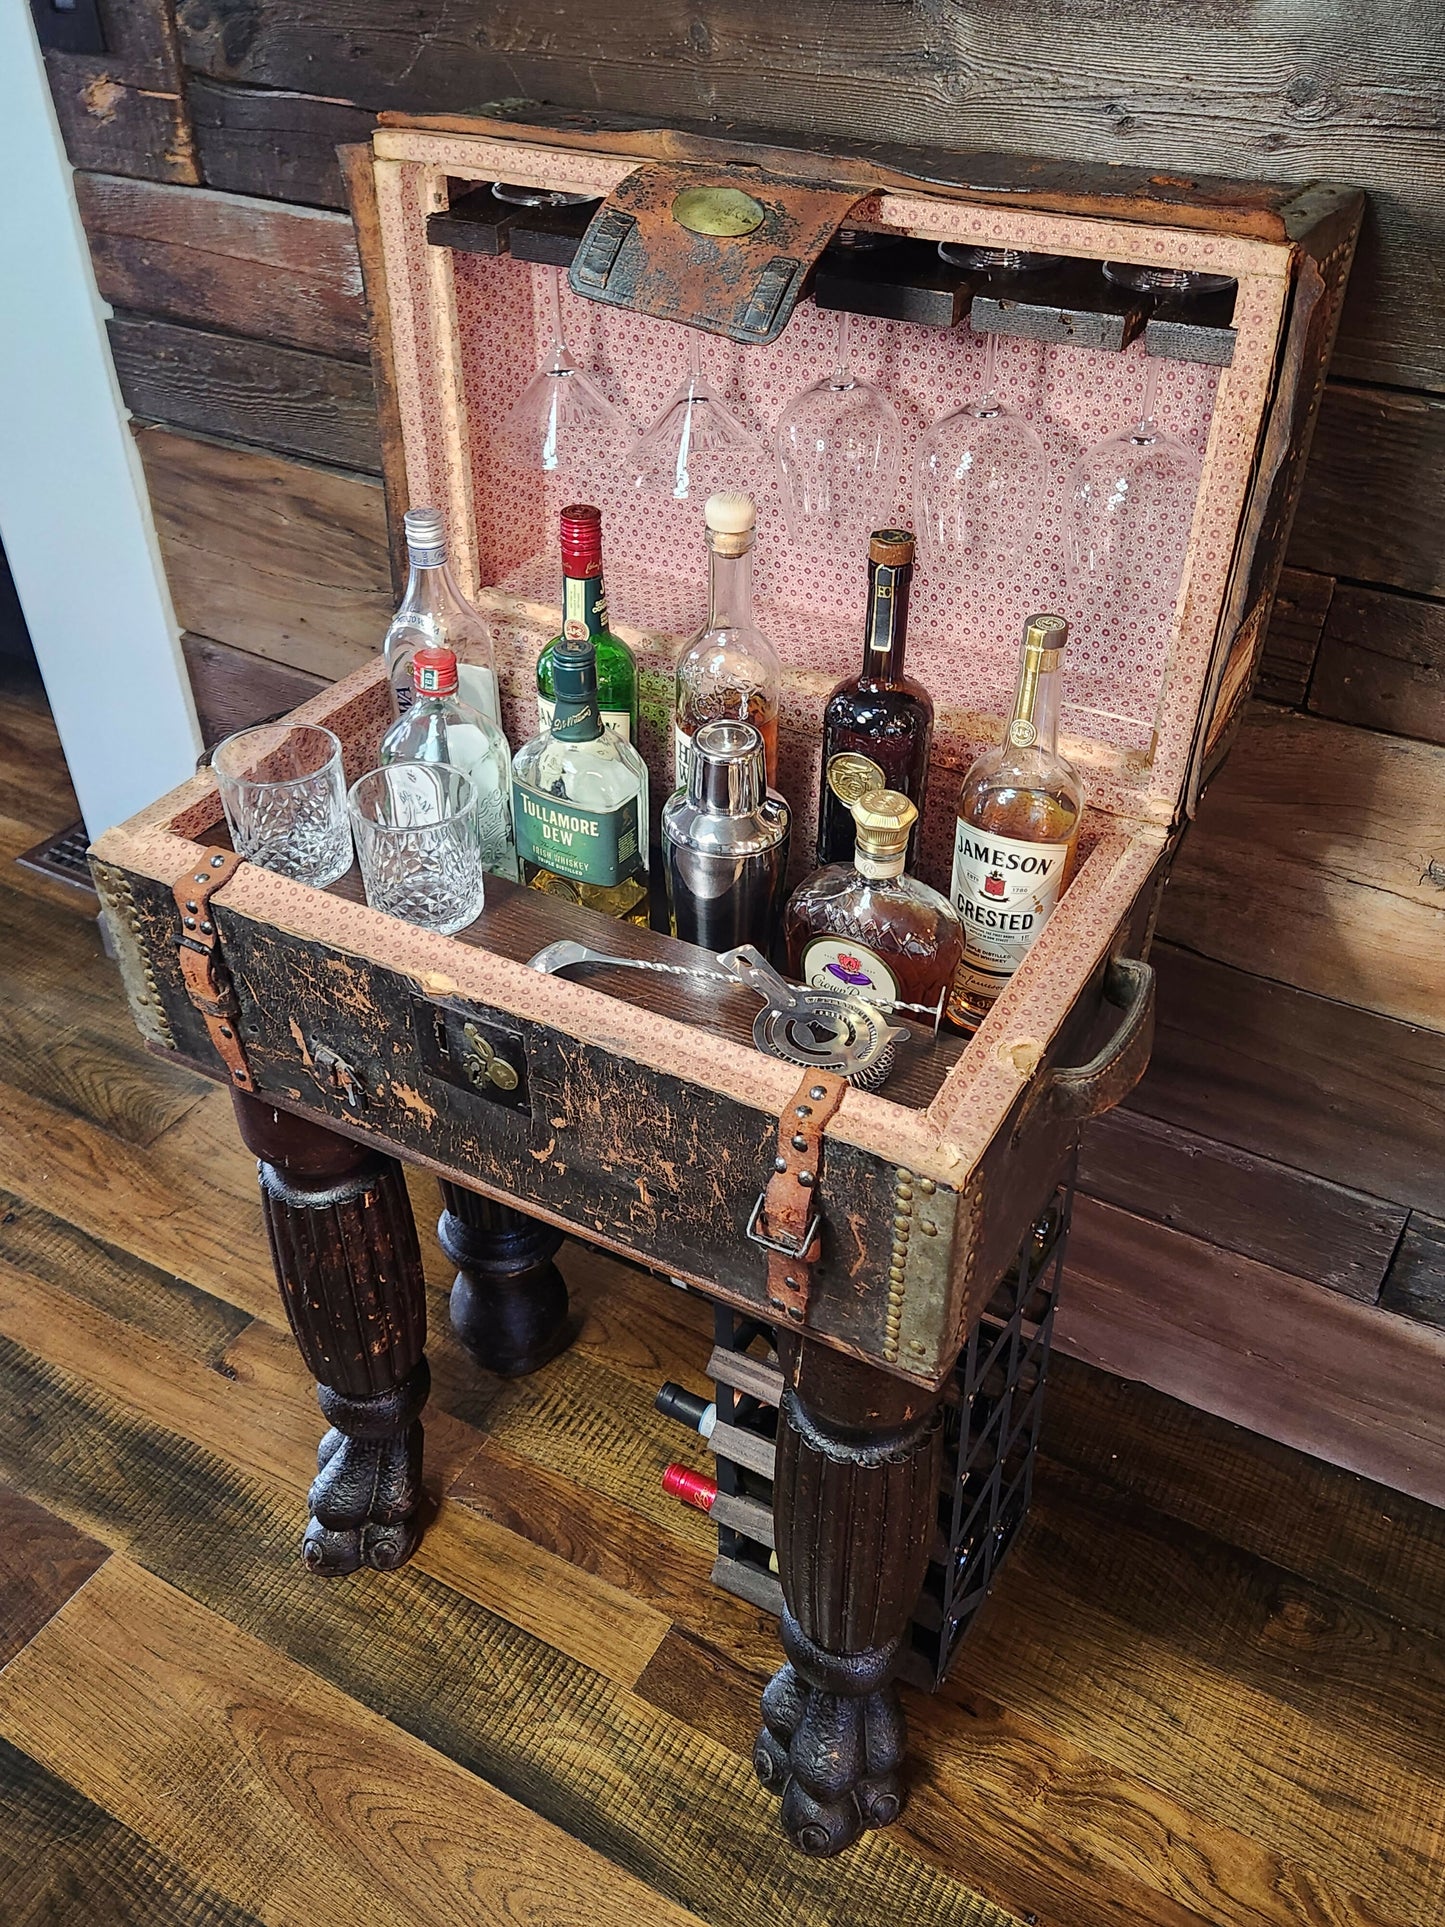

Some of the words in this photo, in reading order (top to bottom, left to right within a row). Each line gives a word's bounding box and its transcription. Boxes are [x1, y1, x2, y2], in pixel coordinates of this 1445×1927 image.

[520, 792, 600, 837] TULLAMORE
[542, 823, 574, 847] DEW
[532, 844, 552, 860] IRISH
[553, 853, 589, 871] WHISKEY
[537, 855, 555, 867] TRIPLE
[555, 863, 583, 876] DISTILLED
[958, 835, 1053, 876] JAMESON
[1012, 886, 1028, 894] 1780
[957, 893, 1034, 931] CRESTED
[980, 954, 1008, 964] WHISKEY
[981, 949, 1012, 960] DISTILLED
